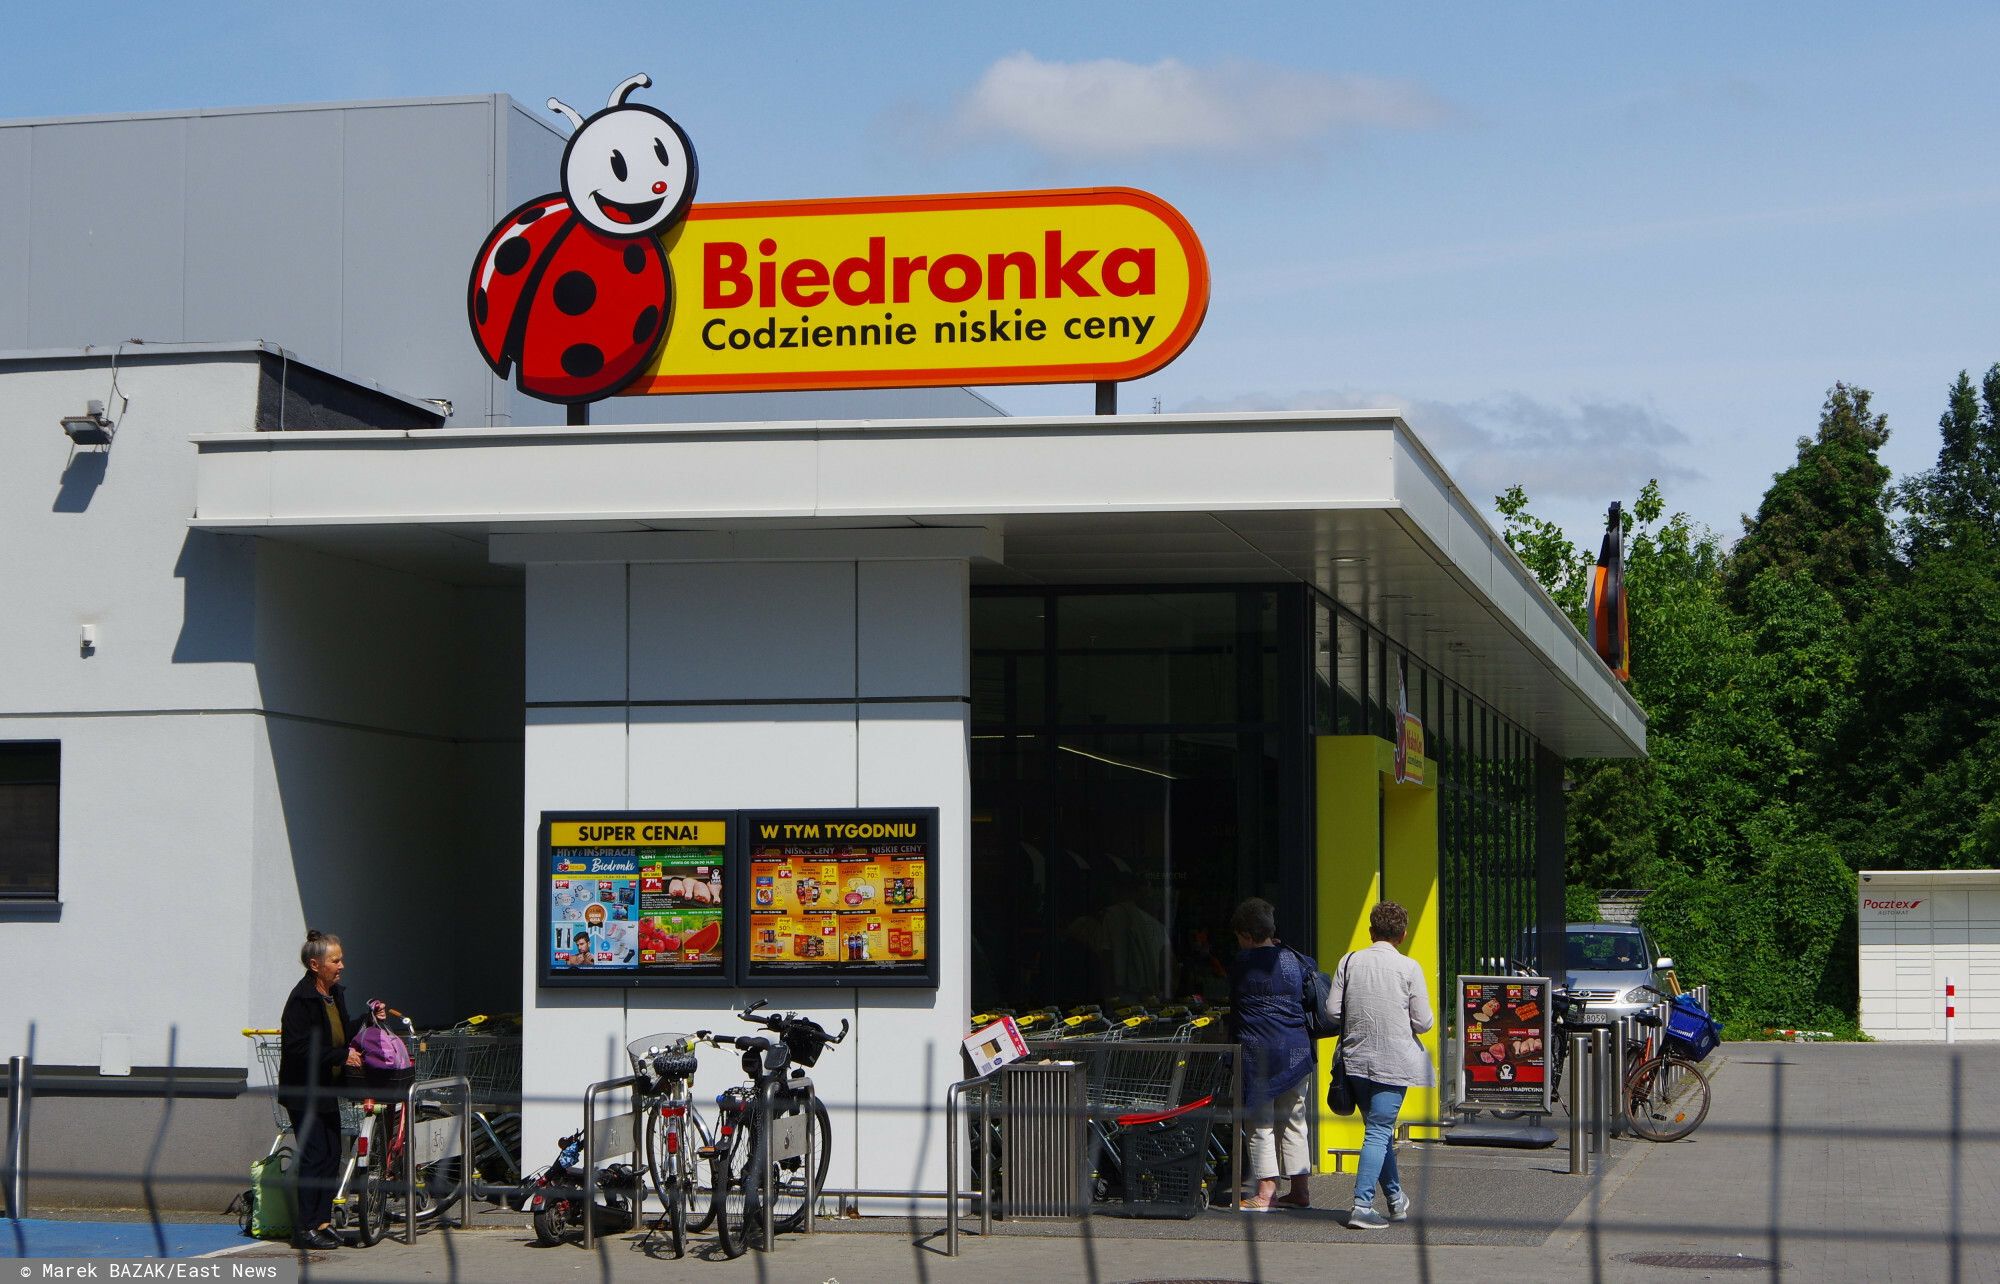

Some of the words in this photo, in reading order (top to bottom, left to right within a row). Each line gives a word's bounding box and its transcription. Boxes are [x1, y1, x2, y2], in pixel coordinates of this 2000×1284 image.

[702, 230, 1156, 310] Biedronka
[702, 312, 917, 351] Codziennie
[934, 309, 1048, 344] niskie
[1063, 314, 1156, 344] ceny
[578, 826, 636, 841] SUPER
[642, 825, 698, 841] CENA!
[760, 825, 779, 839] W
[784, 824, 820, 838] TYM
[825, 823, 917, 838] TYGODNIU
[583, 848, 636, 857] INSPIRACJE
[591, 858, 635, 873] Biedronki
[1863, 899, 1910, 909] Pocztex
